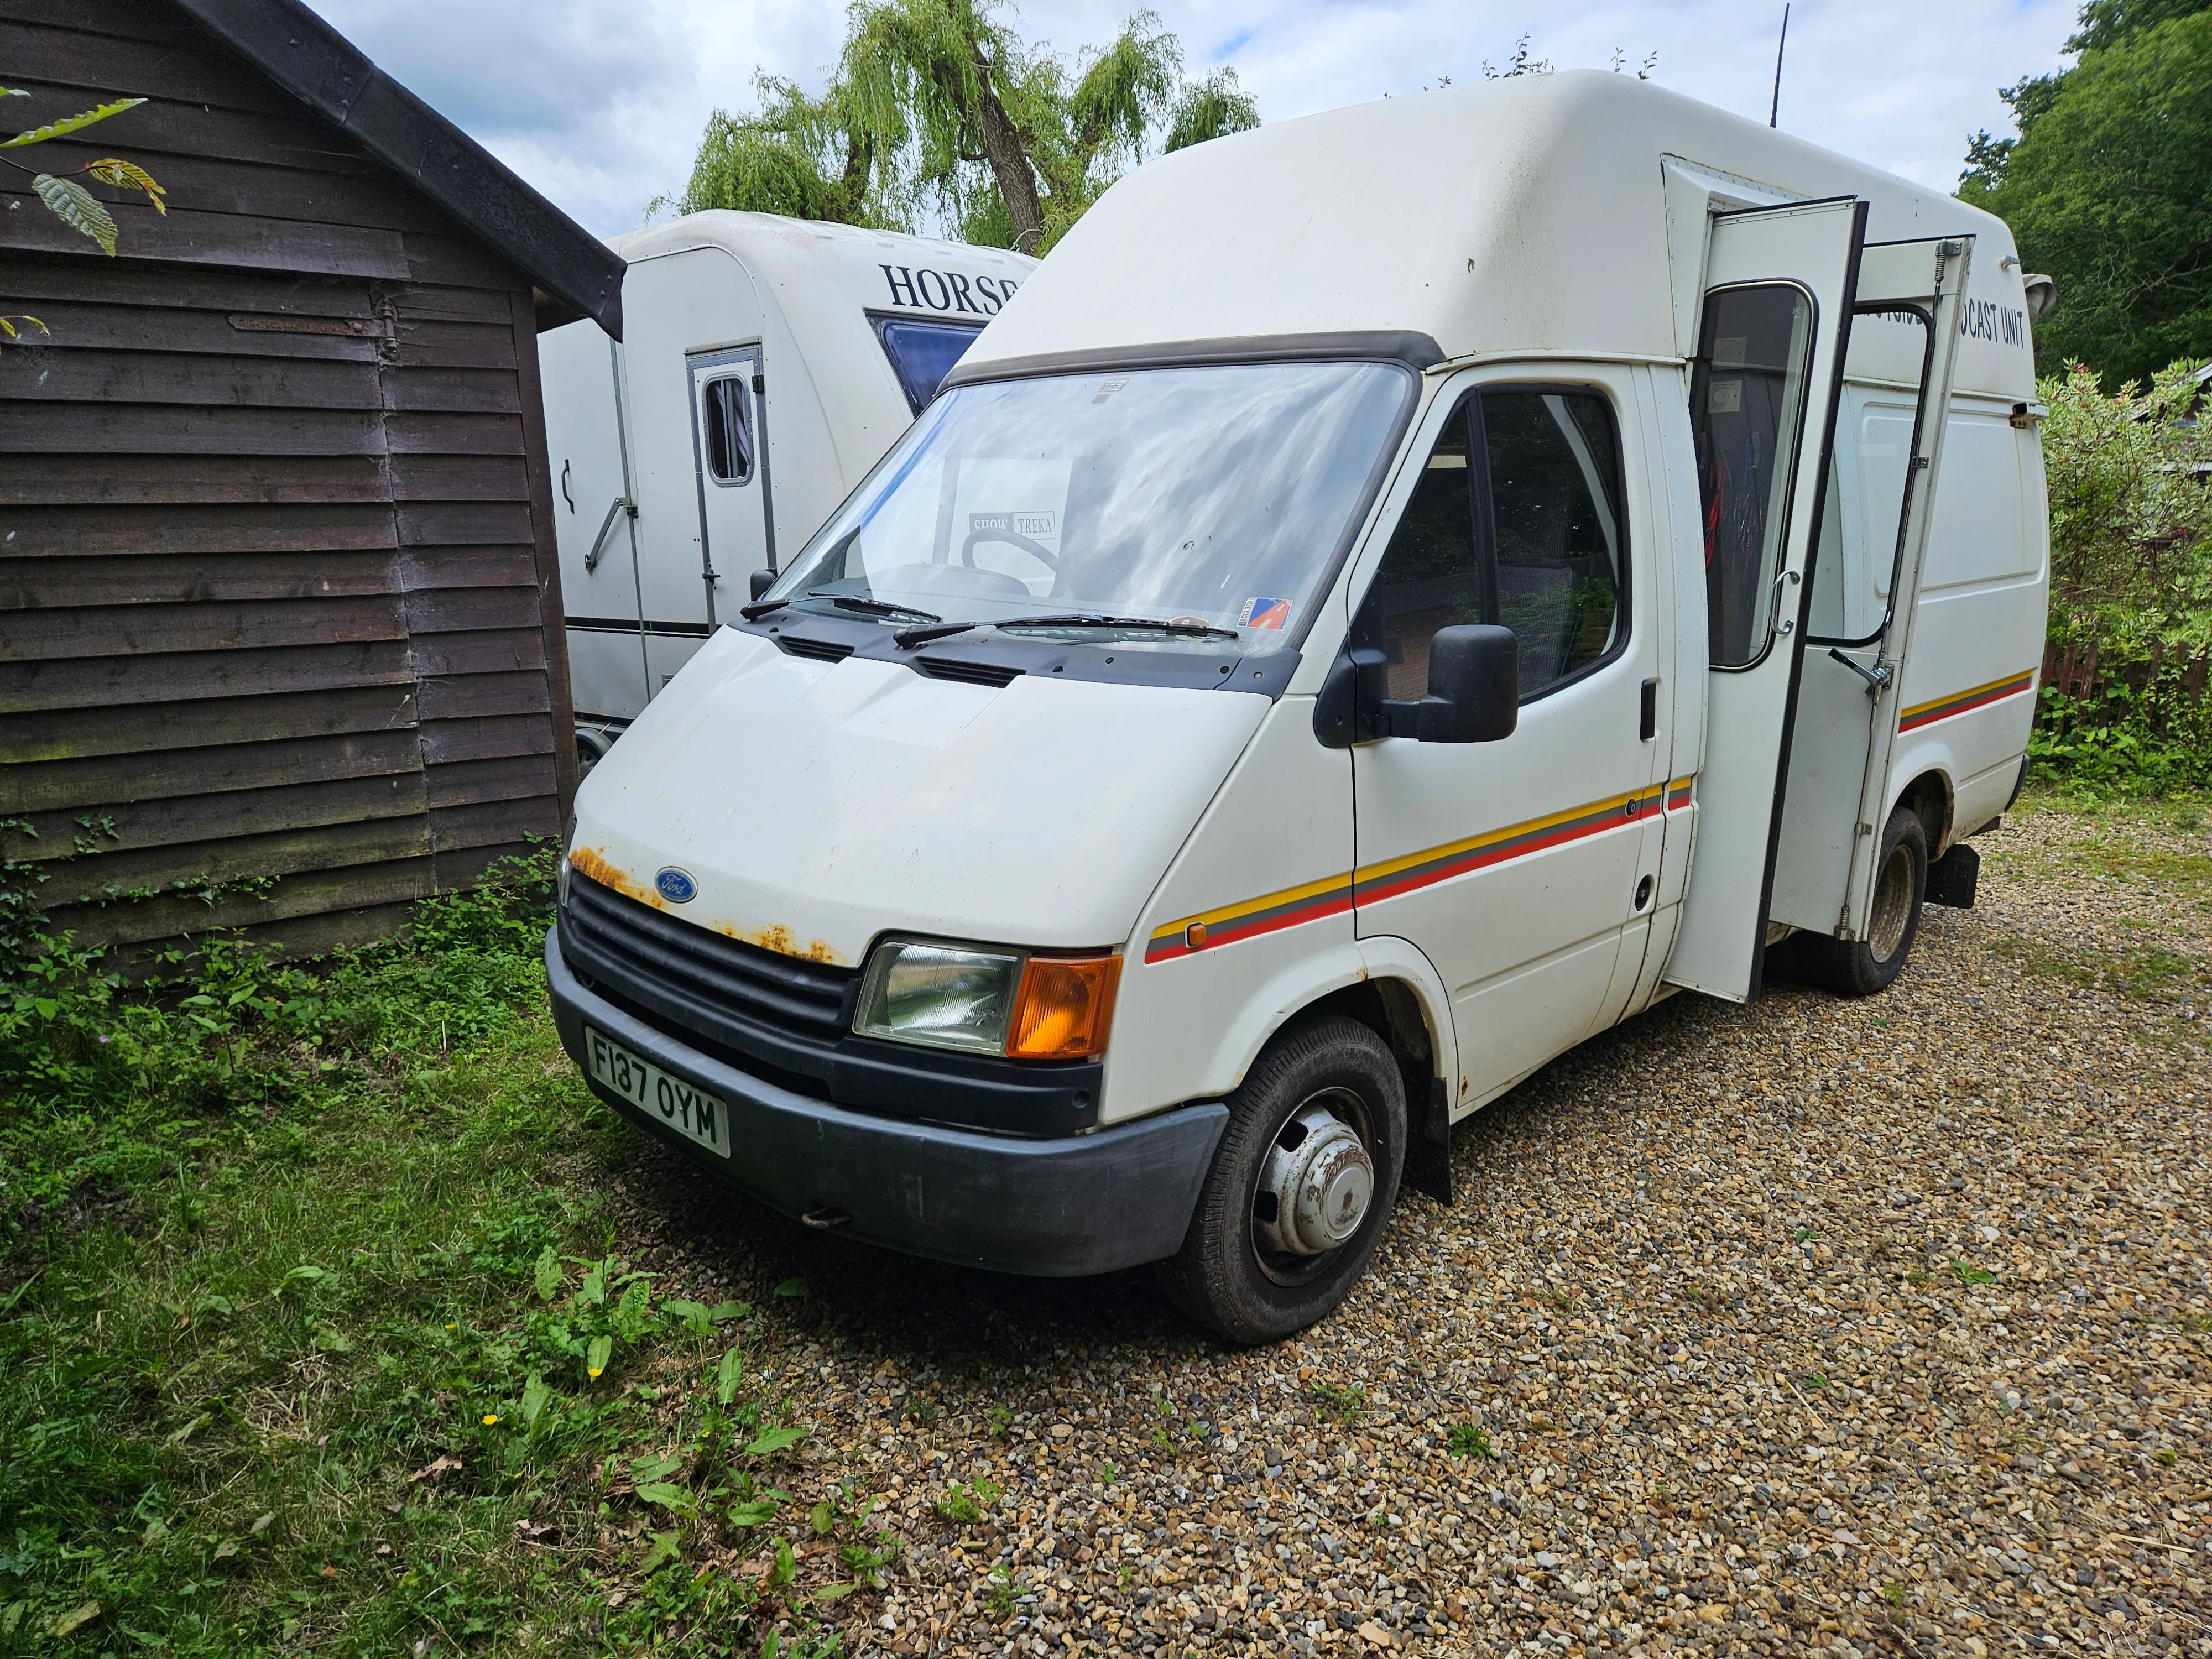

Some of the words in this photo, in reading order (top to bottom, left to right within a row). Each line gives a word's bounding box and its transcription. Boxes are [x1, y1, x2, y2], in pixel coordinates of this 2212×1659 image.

[2001, 306, 2023, 349] UNIT
[1018, 518, 1052, 533] TREKA
[662, 874, 687, 895] Ford
[593, 1035, 647, 1102] F137
[657, 1077, 716, 1144] OYM
